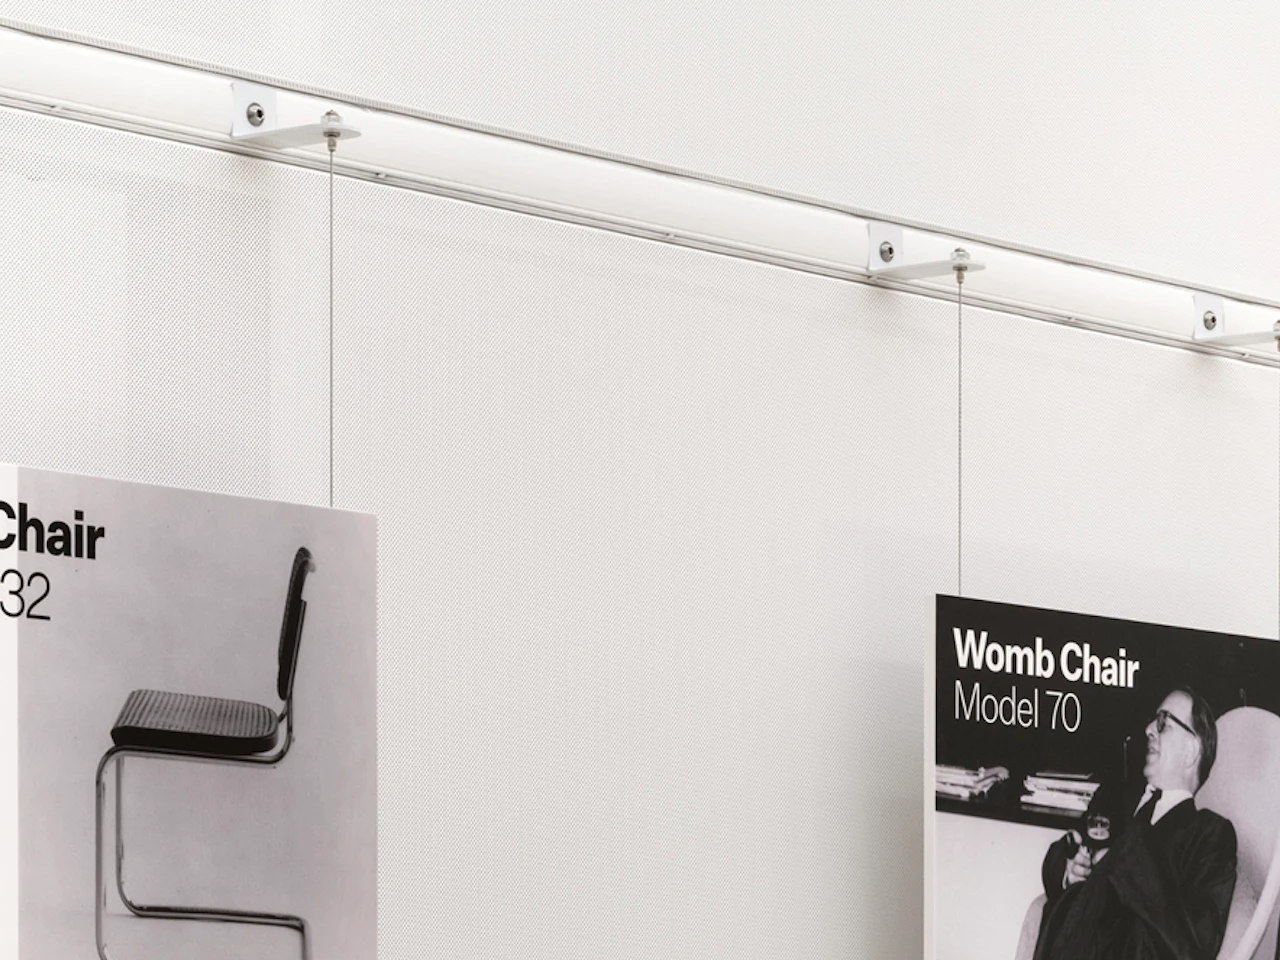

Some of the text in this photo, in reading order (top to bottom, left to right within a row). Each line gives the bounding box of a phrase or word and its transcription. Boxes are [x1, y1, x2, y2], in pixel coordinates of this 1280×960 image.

[953, 627, 1140, 688] Womb Chair
[954, 680, 1082, 732] Model 70
